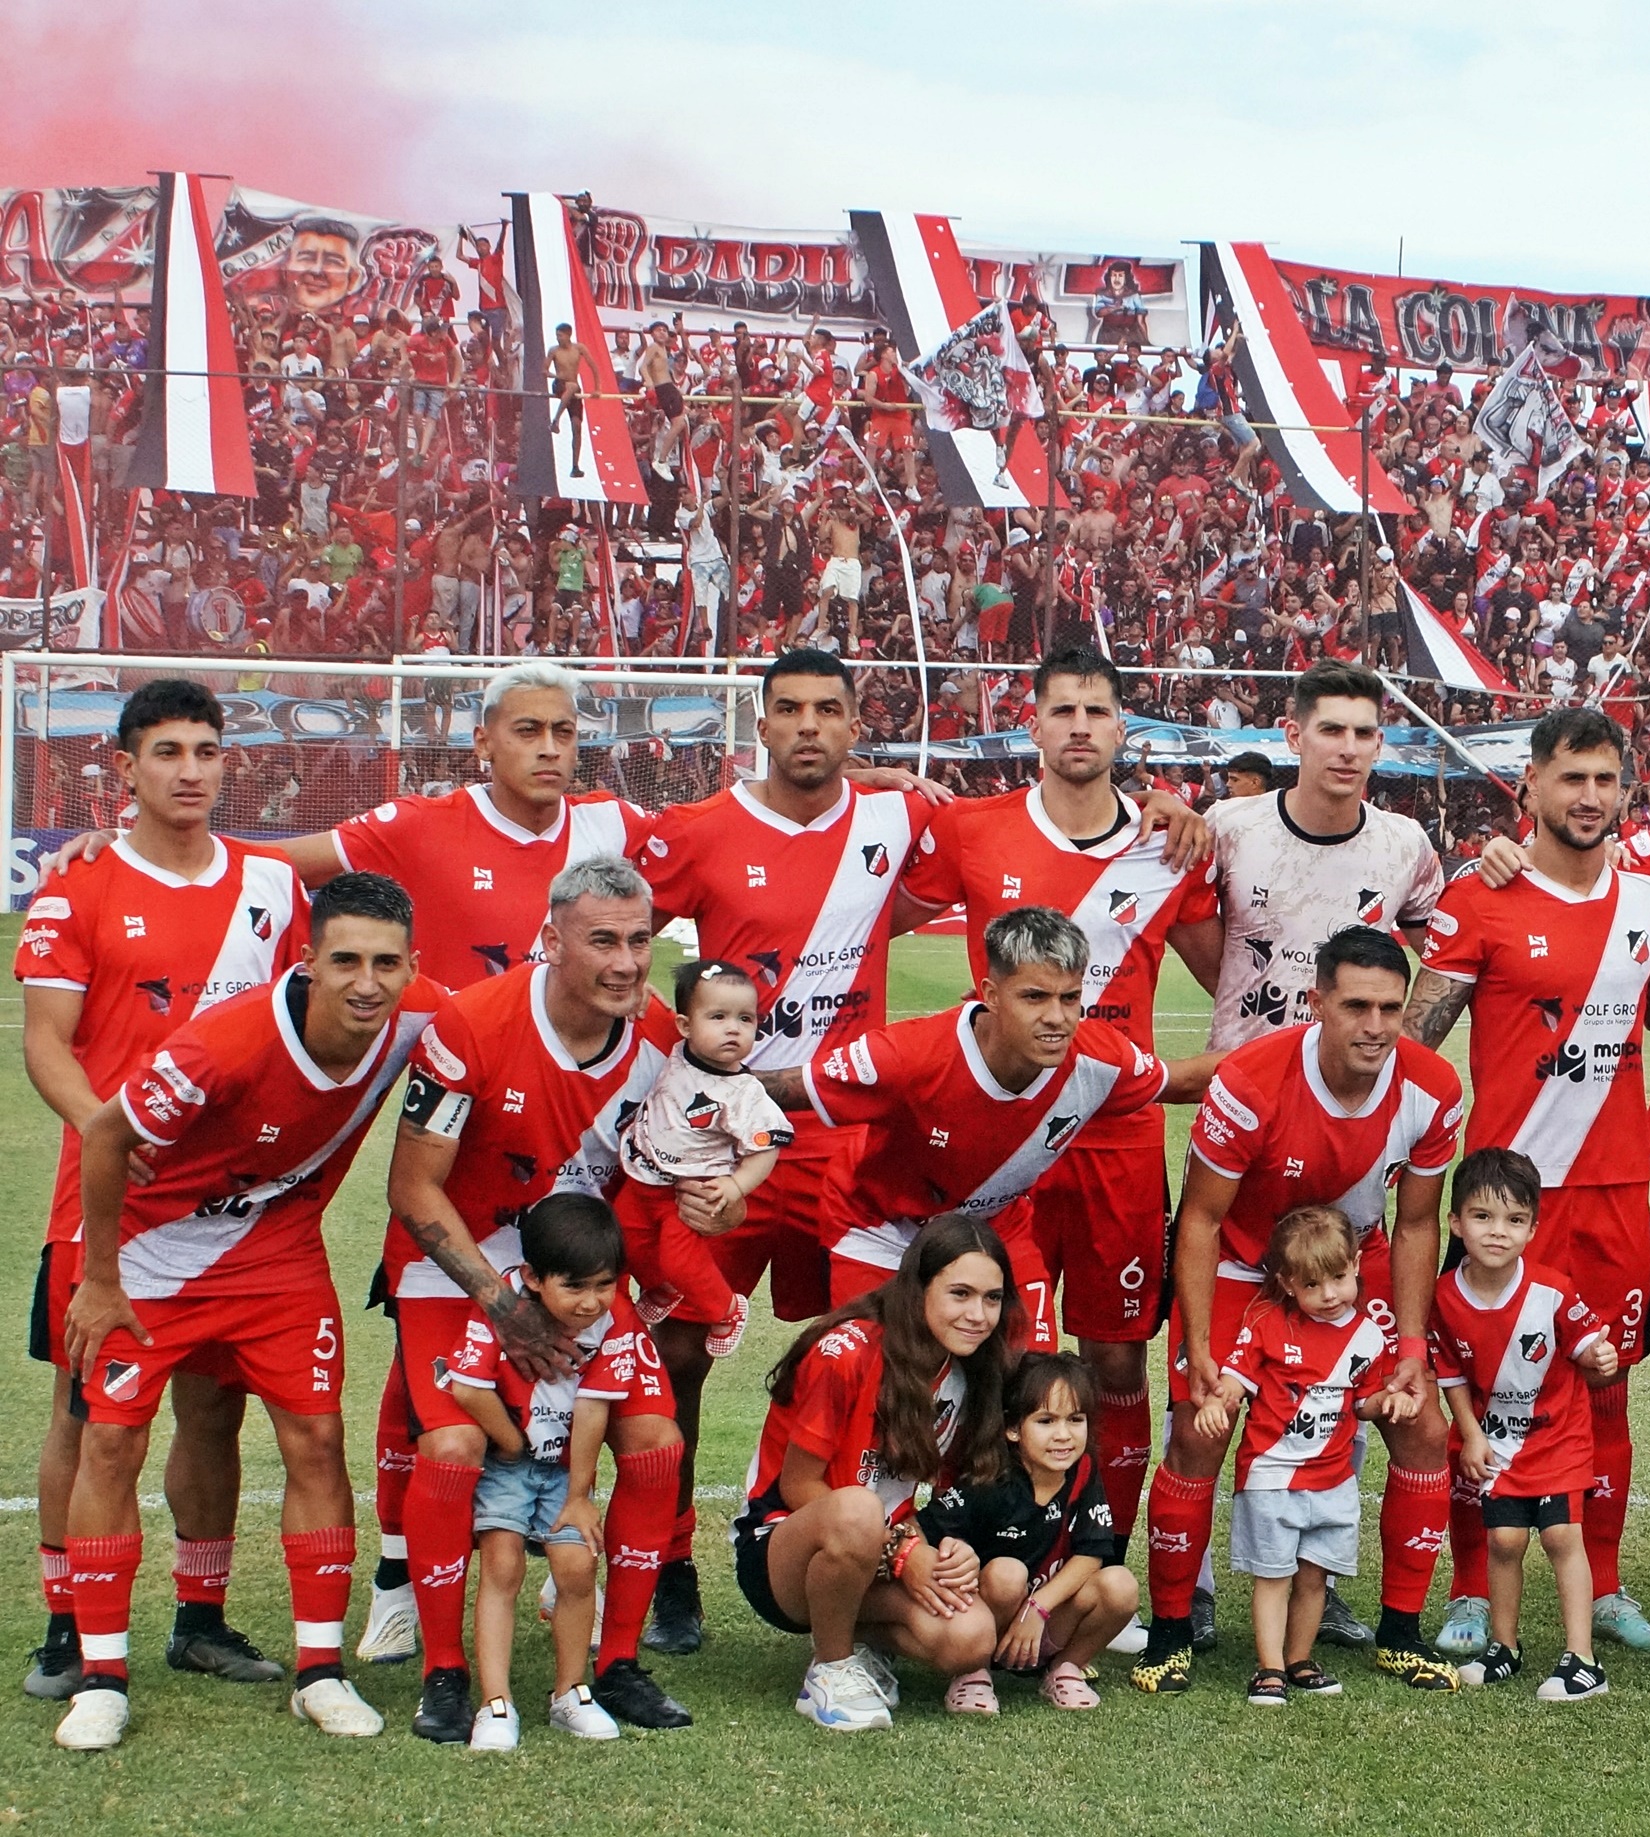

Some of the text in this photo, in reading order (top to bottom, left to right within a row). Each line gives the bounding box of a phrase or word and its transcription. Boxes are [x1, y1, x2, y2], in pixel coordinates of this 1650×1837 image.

[1302, 278, 1611, 379] LA COLNA
[474, 880, 493, 890] IFK
[749, 877, 766, 888] IFK
[1002, 889, 1020, 899] IFK
[1251, 900, 1267, 908] IFK
[126, 927, 146, 938] IFK
[1281, 948, 1317, 965] WOL
[1530, 947, 1548, 958] IFK
[794, 951, 838, 969] WOLF
[1291, 965, 1314, 976] Grupo
[1573, 1003, 1638, 1016] WOLF GRO
[1593, 1042, 1640, 1059] maip
[404, 1079, 425, 1112] C
[503, 1102, 524, 1113] IFK
[1216, 1090, 1252, 1125] AccessFan
[1204, 1120, 1226, 1144] Vida
[929, 1139, 948, 1148] IFK
[1283, 1169, 1302, 1178] IFK
[1120, 1256, 1144, 1290] 6
[1026, 1281, 1046, 1319] 7
[1622, 1288, 1643, 1326] 3
[1124, 1309, 1140, 1318] IFK
[1367, 1298, 1396, 1330] 8
[312, 1318, 337, 1360] 5
[1035, 1332, 1050, 1342] IFK
[1621, 1340, 1635, 1350] IFK
[1285, 1355, 1302, 1364] IFK
[313, 1381, 330, 1391] IFK
[644, 1386, 661, 1396] IFK
[73, 1573, 118, 1583] IFK
[203, 1577, 229, 1587] CD
